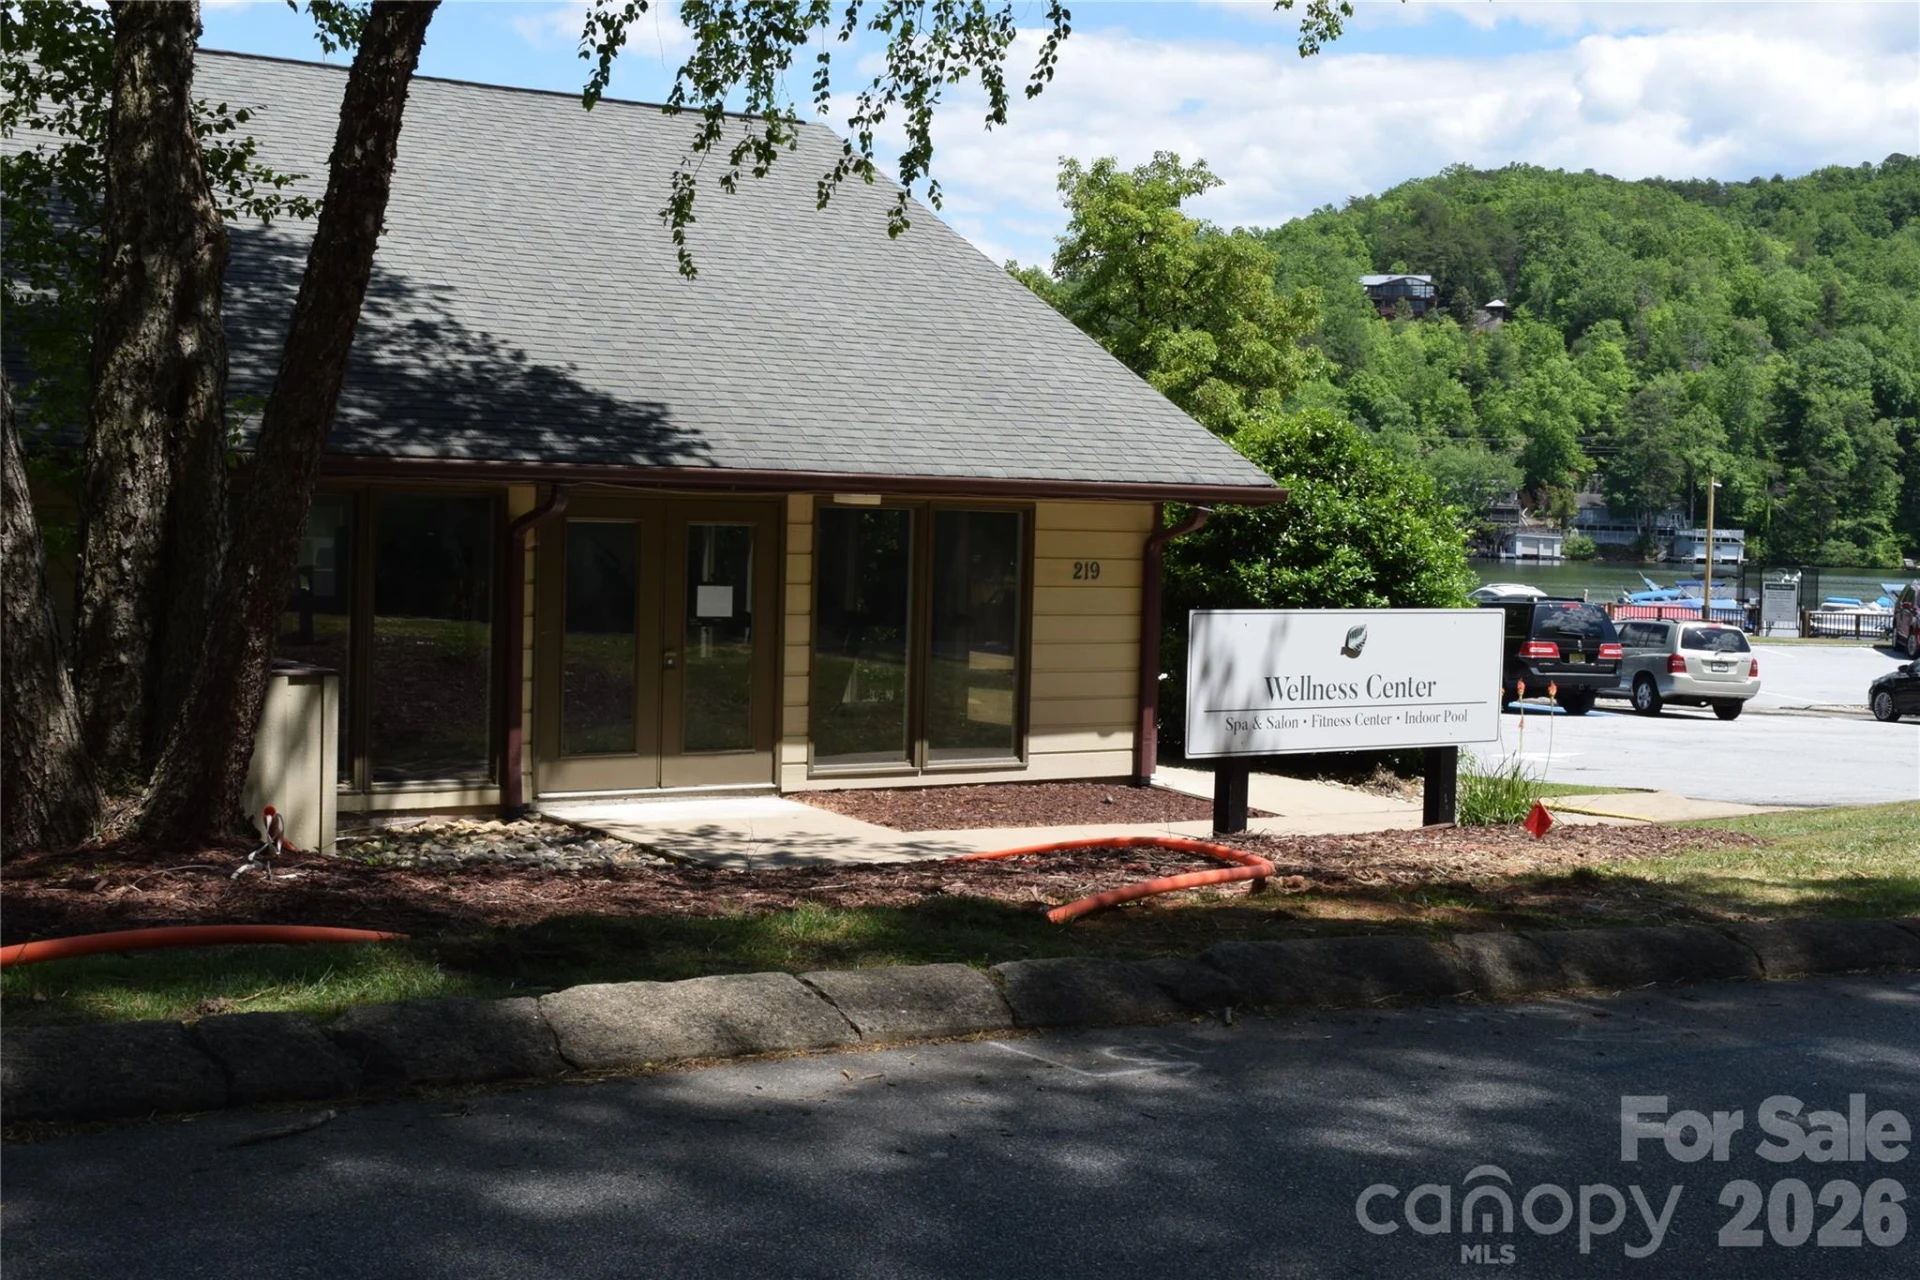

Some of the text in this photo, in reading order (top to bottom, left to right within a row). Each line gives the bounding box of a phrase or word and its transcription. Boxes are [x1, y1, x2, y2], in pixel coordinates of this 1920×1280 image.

[1072, 561, 1100, 580] 219
[1264, 674, 1437, 701] Wellness Center
[1225, 709, 1468, 735] Spa & Salon Fitness Center Indoor Pool
